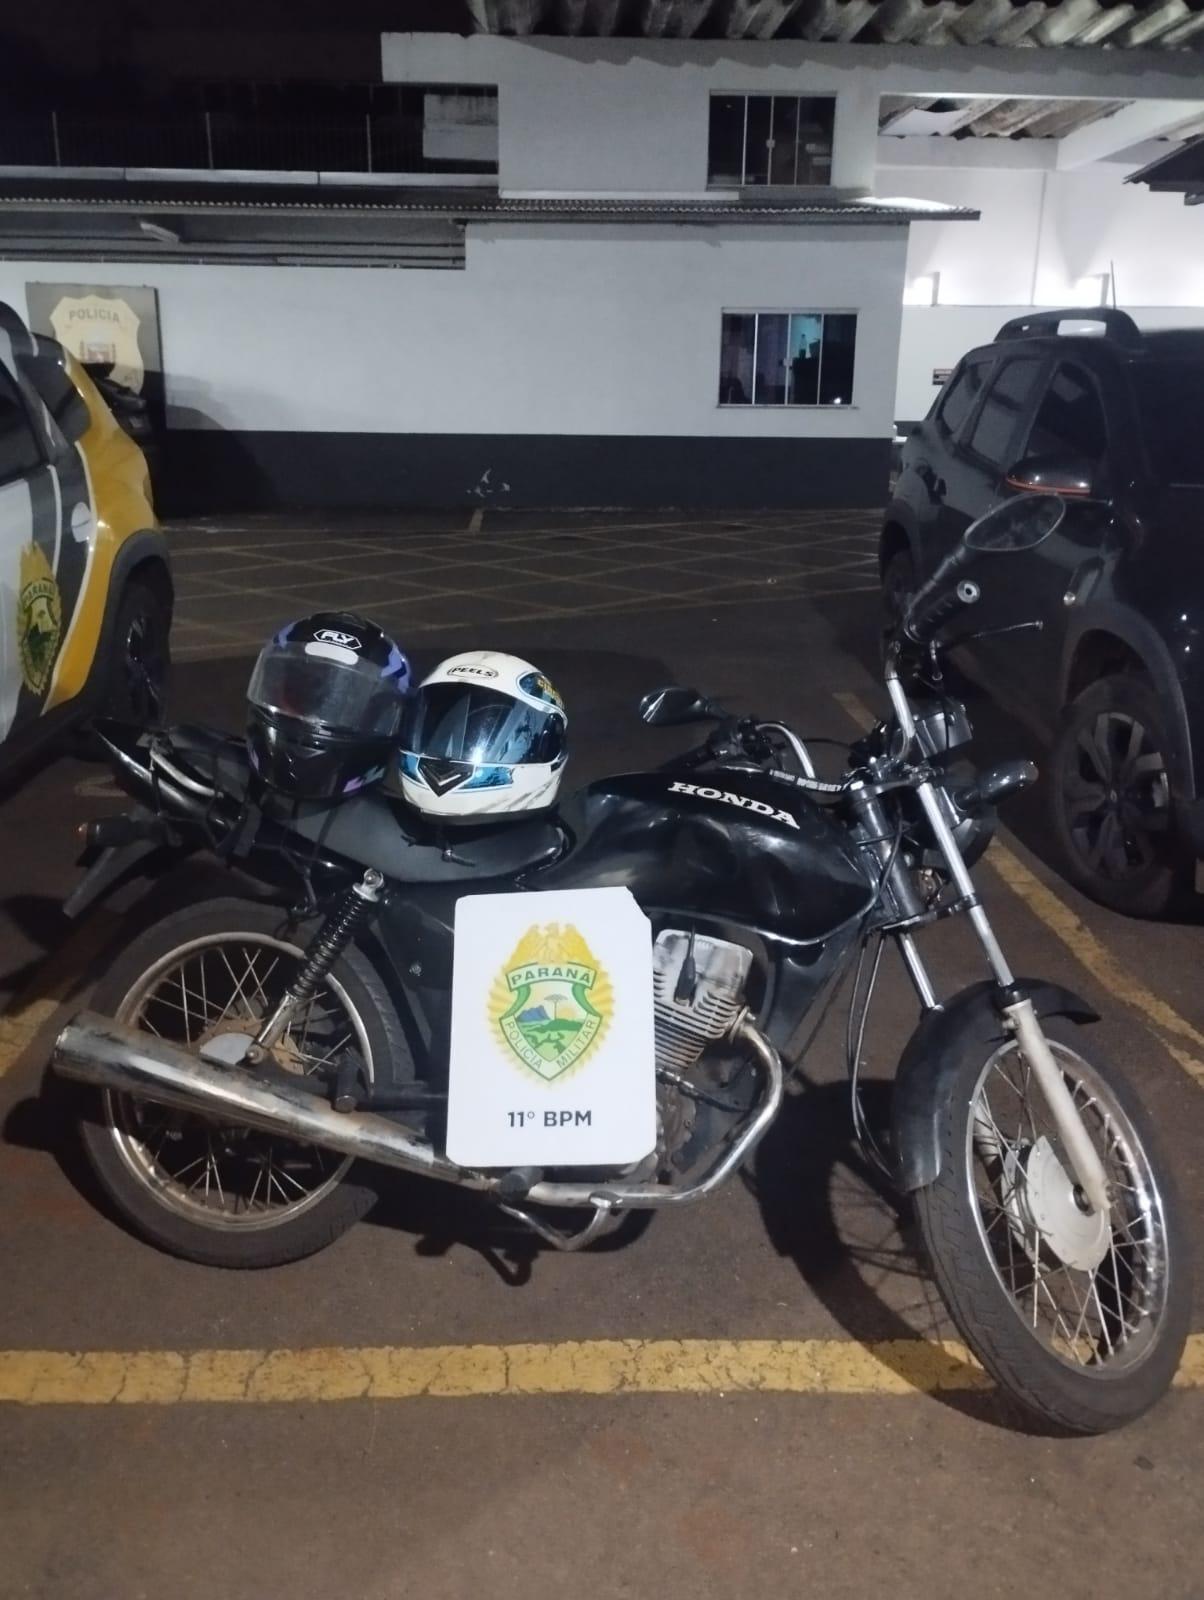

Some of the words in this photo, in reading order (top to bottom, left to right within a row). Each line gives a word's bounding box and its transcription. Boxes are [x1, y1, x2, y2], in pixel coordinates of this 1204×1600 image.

[321, 631, 354, 644] FLY
[451, 667, 493, 677] PEELS
[668, 782, 800, 830] HONDA
[556, 1019, 596, 1069] MILITAR
[544, 1110, 592, 1127] BPM
